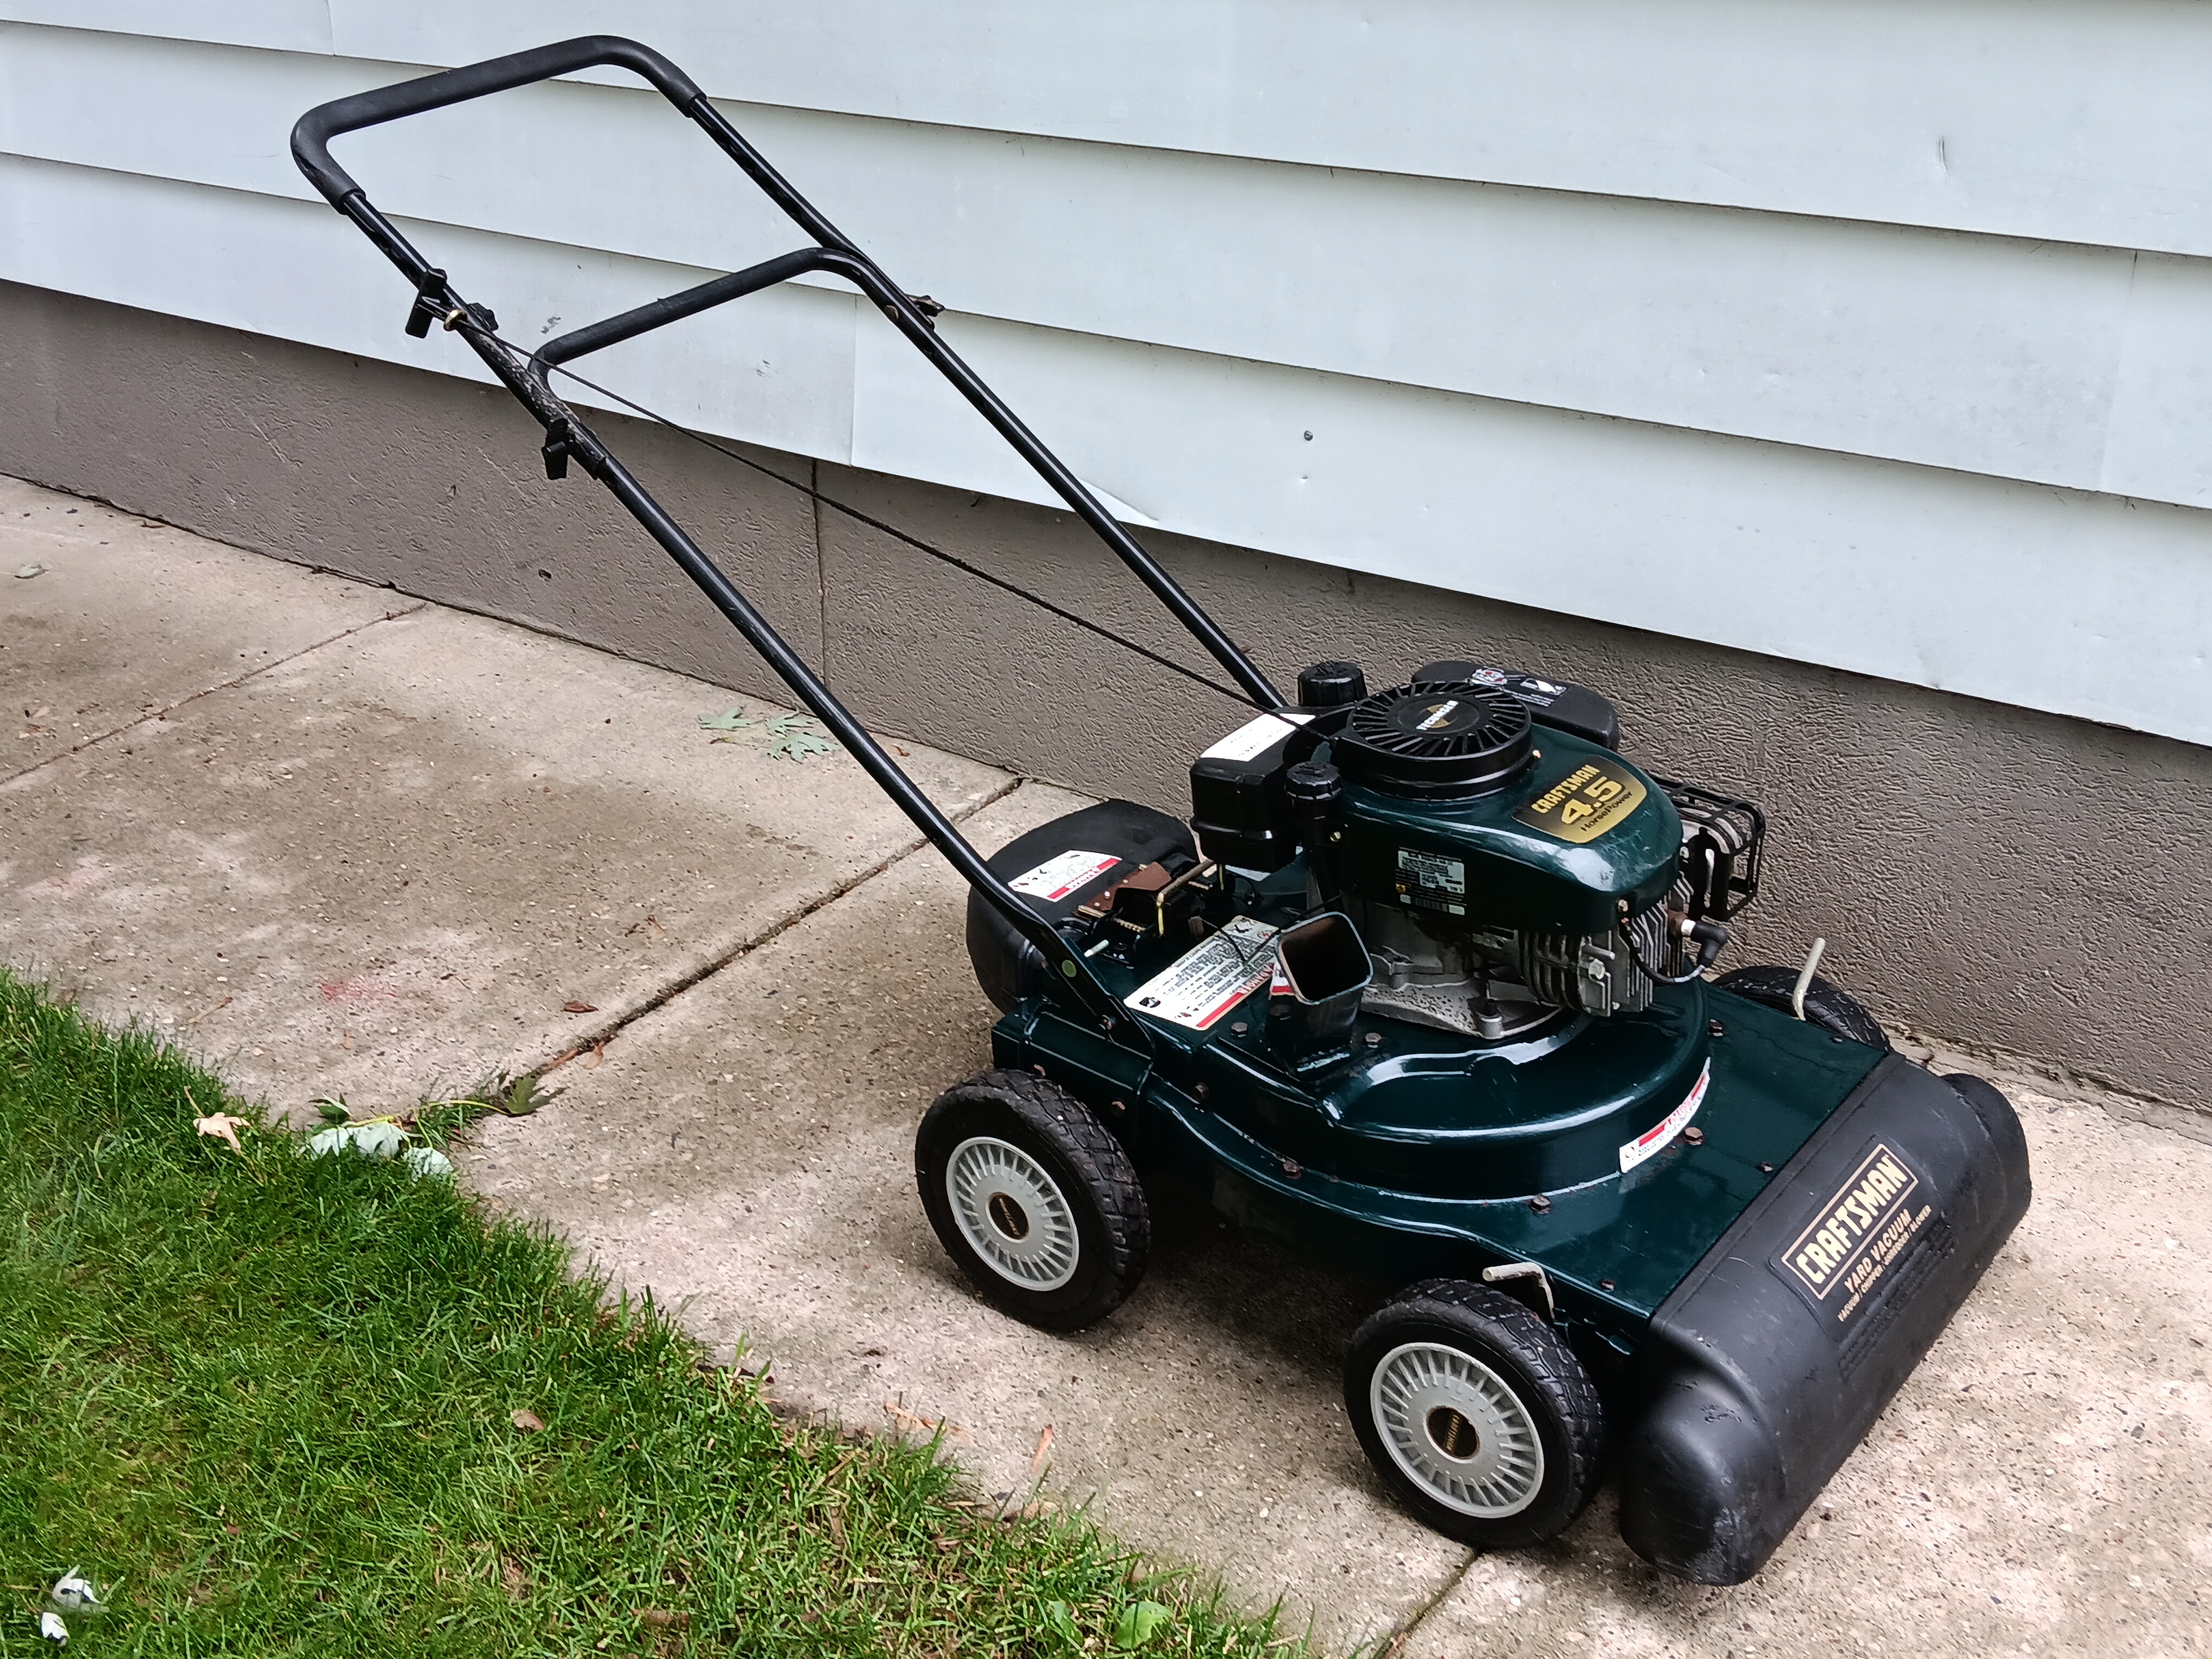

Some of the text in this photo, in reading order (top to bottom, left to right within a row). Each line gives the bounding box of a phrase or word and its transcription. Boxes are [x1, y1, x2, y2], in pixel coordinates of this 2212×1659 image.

[1531, 764, 1600, 813] CRAFTSMAN
[1561, 776, 1623, 824] 4.5
[1796, 1155, 1908, 1283] CRAFTSMAN
[1844, 1208, 1912, 1293] YARD VACUUM
